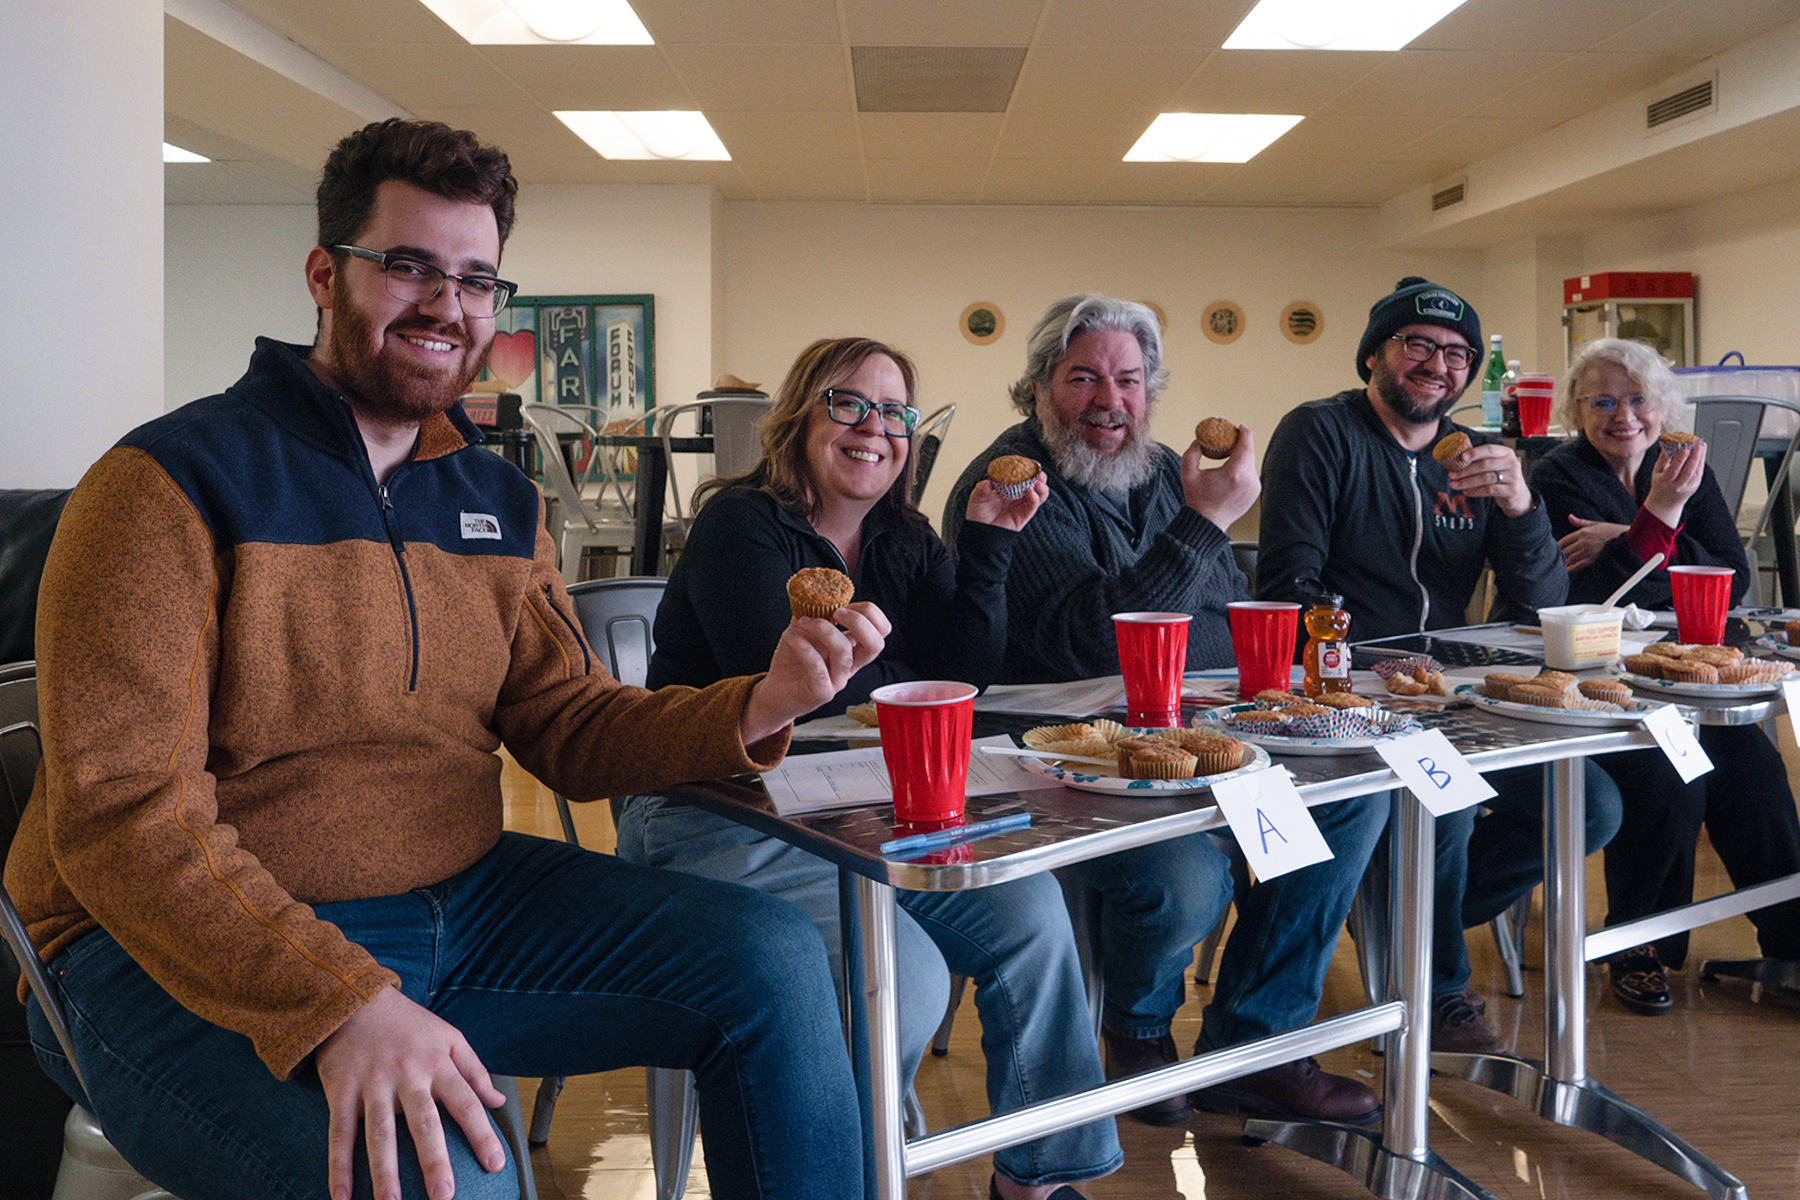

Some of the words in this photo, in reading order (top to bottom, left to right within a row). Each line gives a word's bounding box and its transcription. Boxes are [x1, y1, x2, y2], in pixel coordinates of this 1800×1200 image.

[560, 324, 580, 397] FAR
[610, 327, 621, 408] FORUM
[470, 410, 493, 421] MEZZ
[1664, 726, 1687, 757] C
[1417, 756, 1451, 790] B
[1256, 807, 1288, 854] A
